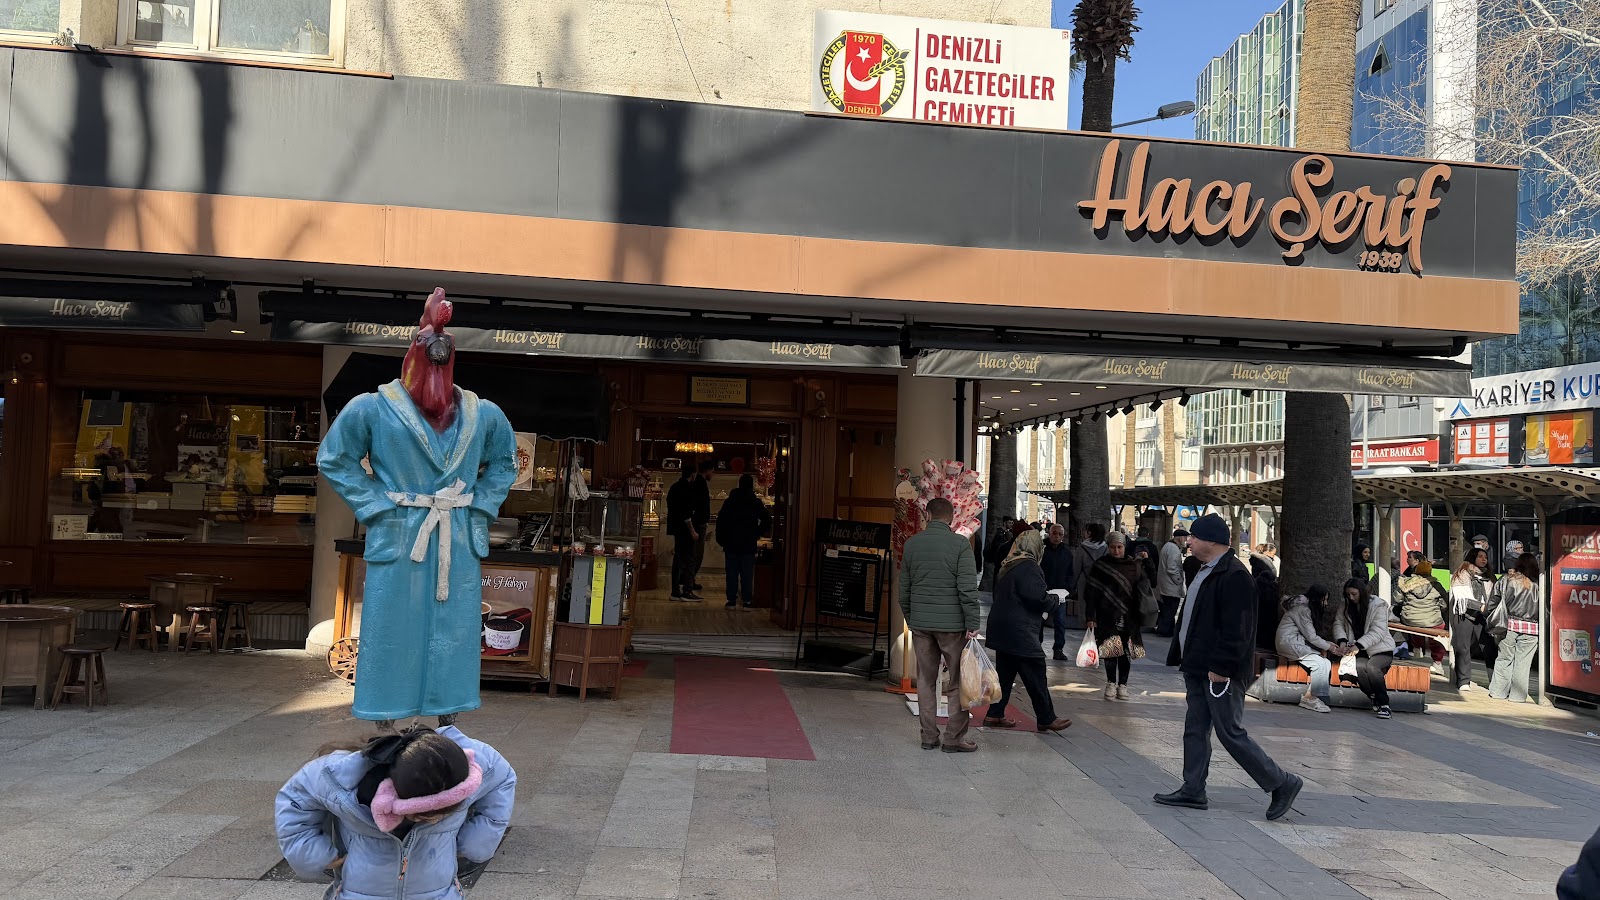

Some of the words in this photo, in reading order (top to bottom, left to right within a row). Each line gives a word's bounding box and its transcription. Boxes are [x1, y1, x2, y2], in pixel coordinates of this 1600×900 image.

[852, 34, 876, 44] 1970
[926, 33, 1002, 64] DENİZLİ
[924, 66, 1055, 101] GAZETECİLER
[847, 105, 878, 115] DENİZLİ
[1076, 138, 1265, 237] Hacı
[1268, 154, 1452, 273] Şerif
[1358, 249, 1403, 271] 1938
[49, 298, 88, 316] Hacı
[90, 300, 131, 320] Şerif
[977, 353, 1008, 369] Hacı
[1009, 354, 1041, 374] Şerif
[1102, 359, 1134, 375] Hacı
[1134, 360, 1168, 380] Şerif
[1231, 363, 1260, 380] Hacı
[1261, 365, 1293, 385] Şerif
[1357, 369, 1386, 385] Hacı
[1386, 371, 1416, 389] Şerif
[1474, 379, 1556, 408] KARİYER
[1367, 447, 1389, 458] İRAAT
[1390, 446, 1425, 457] BANKASI
[1561, 573, 1589, 582] TERAS
[1568, 588, 1600, 609] AÇIL
